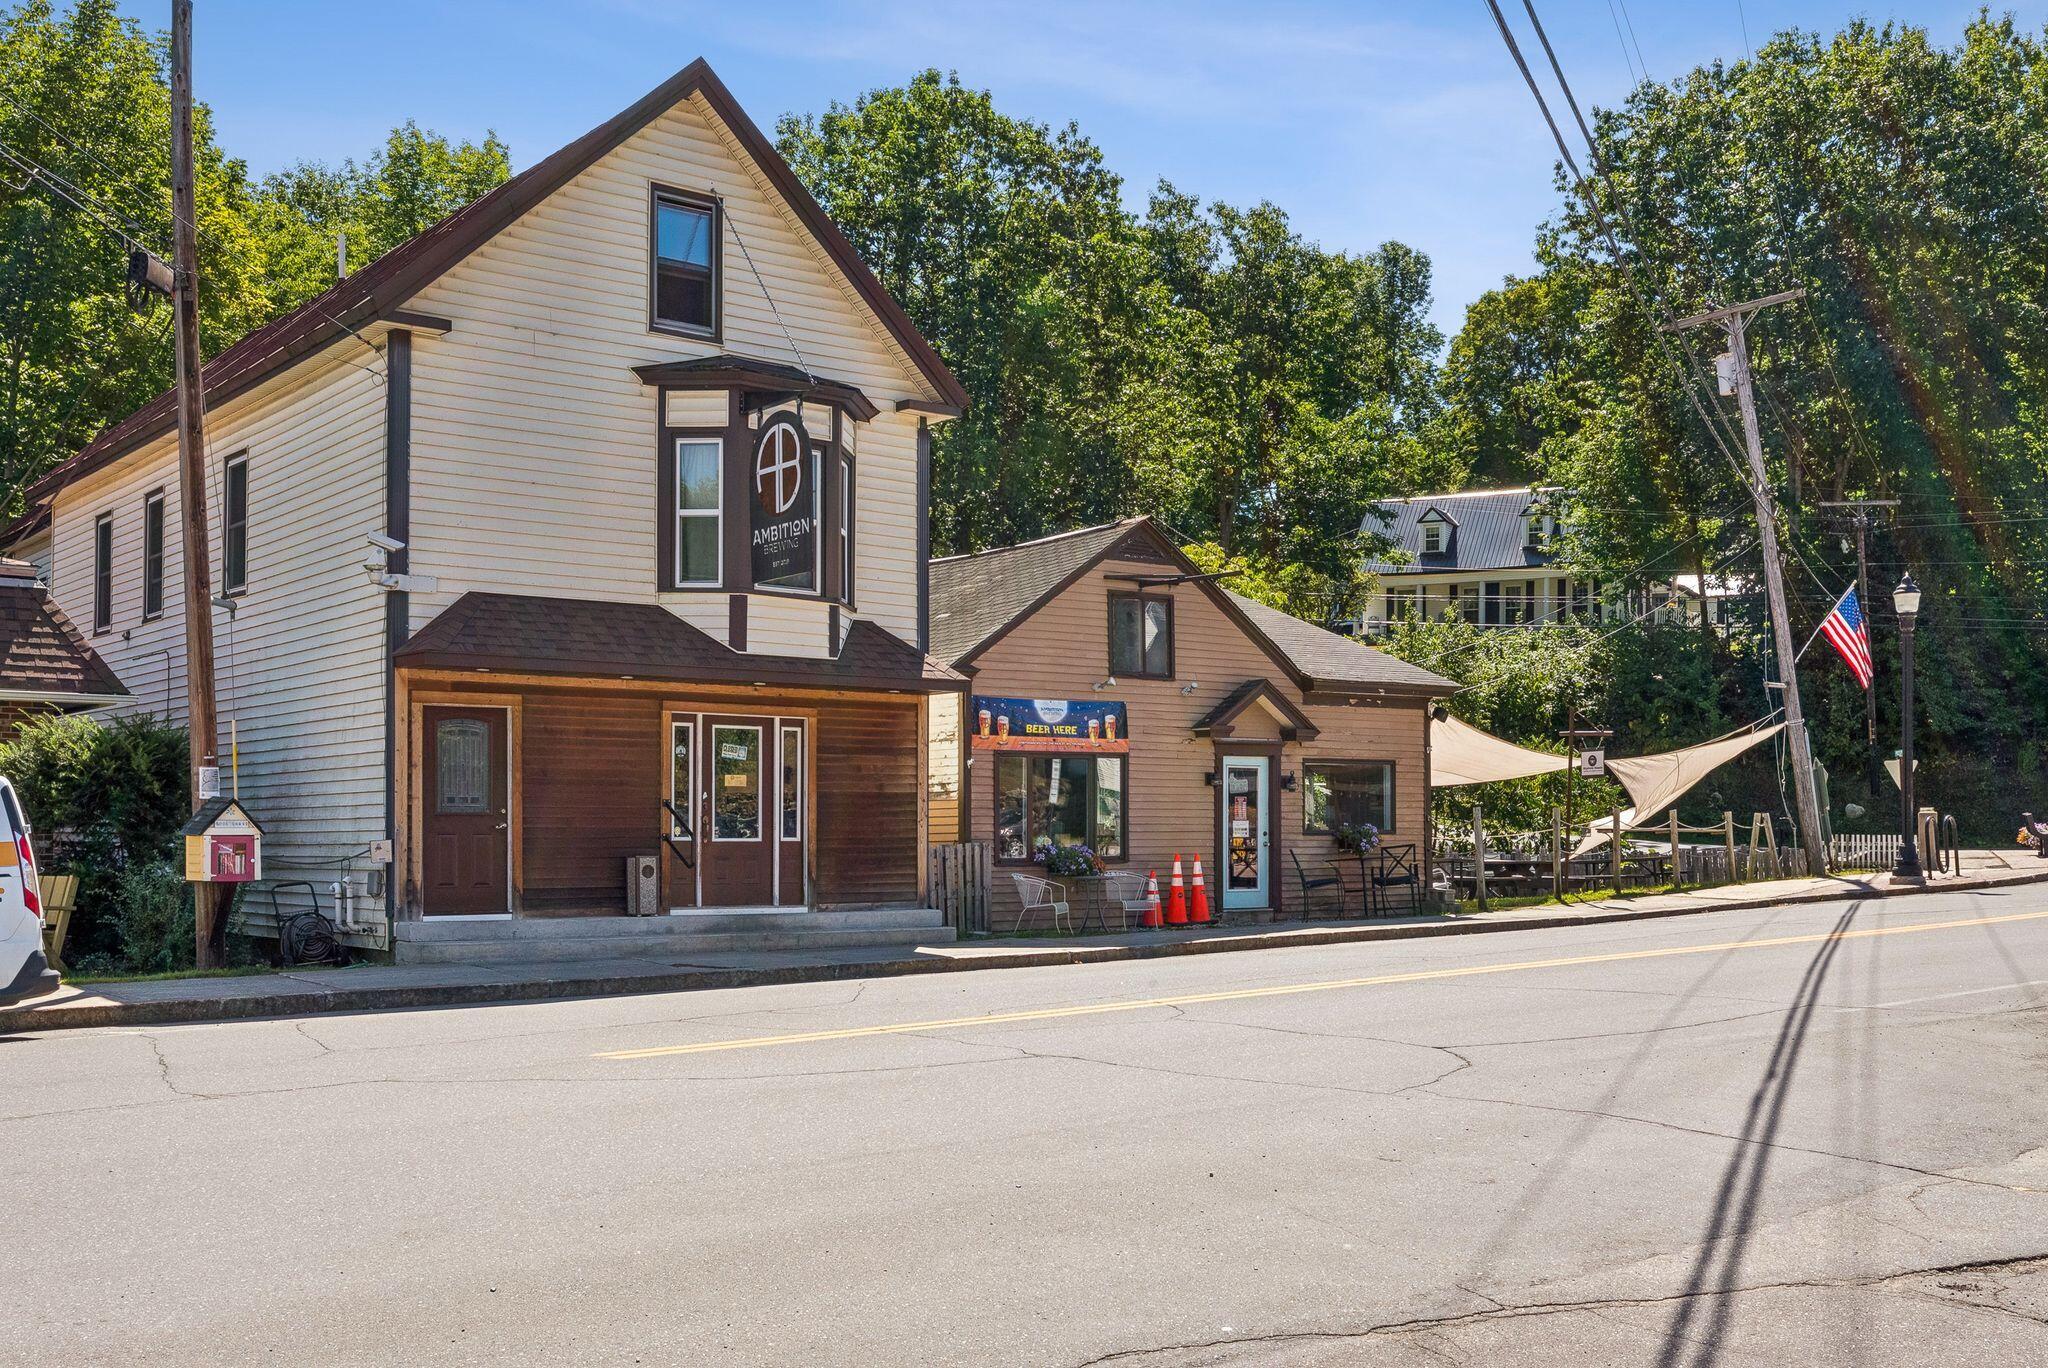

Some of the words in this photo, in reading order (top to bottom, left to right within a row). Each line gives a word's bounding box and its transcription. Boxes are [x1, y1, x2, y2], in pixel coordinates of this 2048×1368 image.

[753, 517, 810, 546] AMBITION
[763, 537, 799, 555] BREWING
[1026, 724, 1050, 734] BEER
[1053, 725, 1078, 735] HERE
